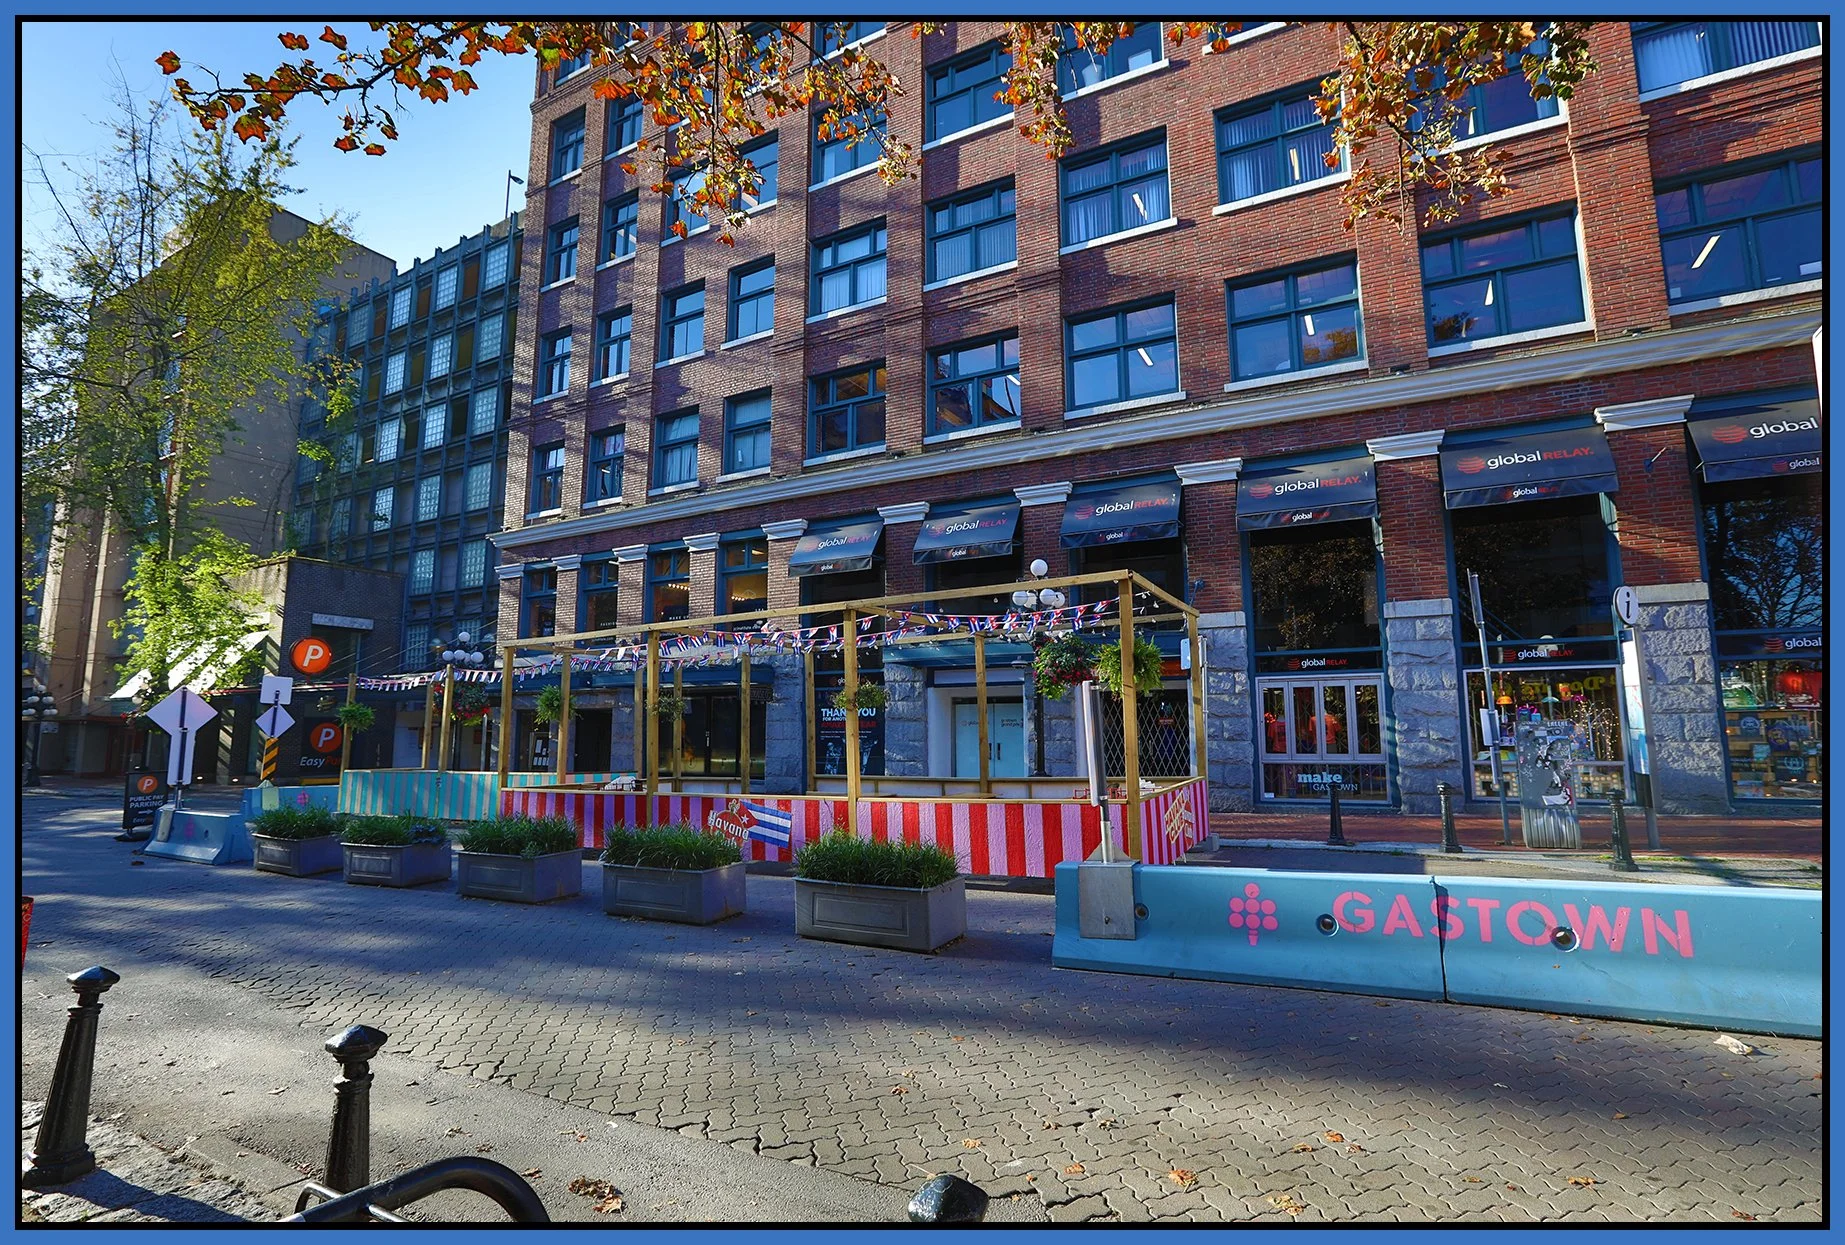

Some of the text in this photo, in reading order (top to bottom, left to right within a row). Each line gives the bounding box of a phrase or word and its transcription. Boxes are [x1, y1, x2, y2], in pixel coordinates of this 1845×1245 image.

[1749, 417, 1818, 438] global
[1487, 450, 1542, 470] global
[1789, 457, 1820, 469] global
[1274, 478, 1319, 495] global
[1512, 486, 1538, 498] global
[1095, 500, 1134, 516] global
[1291, 512, 1312, 522] global
[946, 520, 979, 535] global
[1105, 531, 1123, 541] global
[817, 536, 847, 550] global
[951, 549, 967, 558] global
[820, 563, 833, 572] global
[1785, 637, 1822, 650] global
[303, 645, 324, 667] P
[1517, 649, 1548, 660] global
[1301, 658, 1326, 669] global
[821, 708, 876, 717] THAN YOU
[318, 728, 335, 747] P
[300, 756, 325, 767] Easy
[1297, 772, 1343, 783] make
[143, 778, 153, 791] P
[708, 810, 749, 840] Havana
[1333, 891, 1694, 958] GASTOWN
